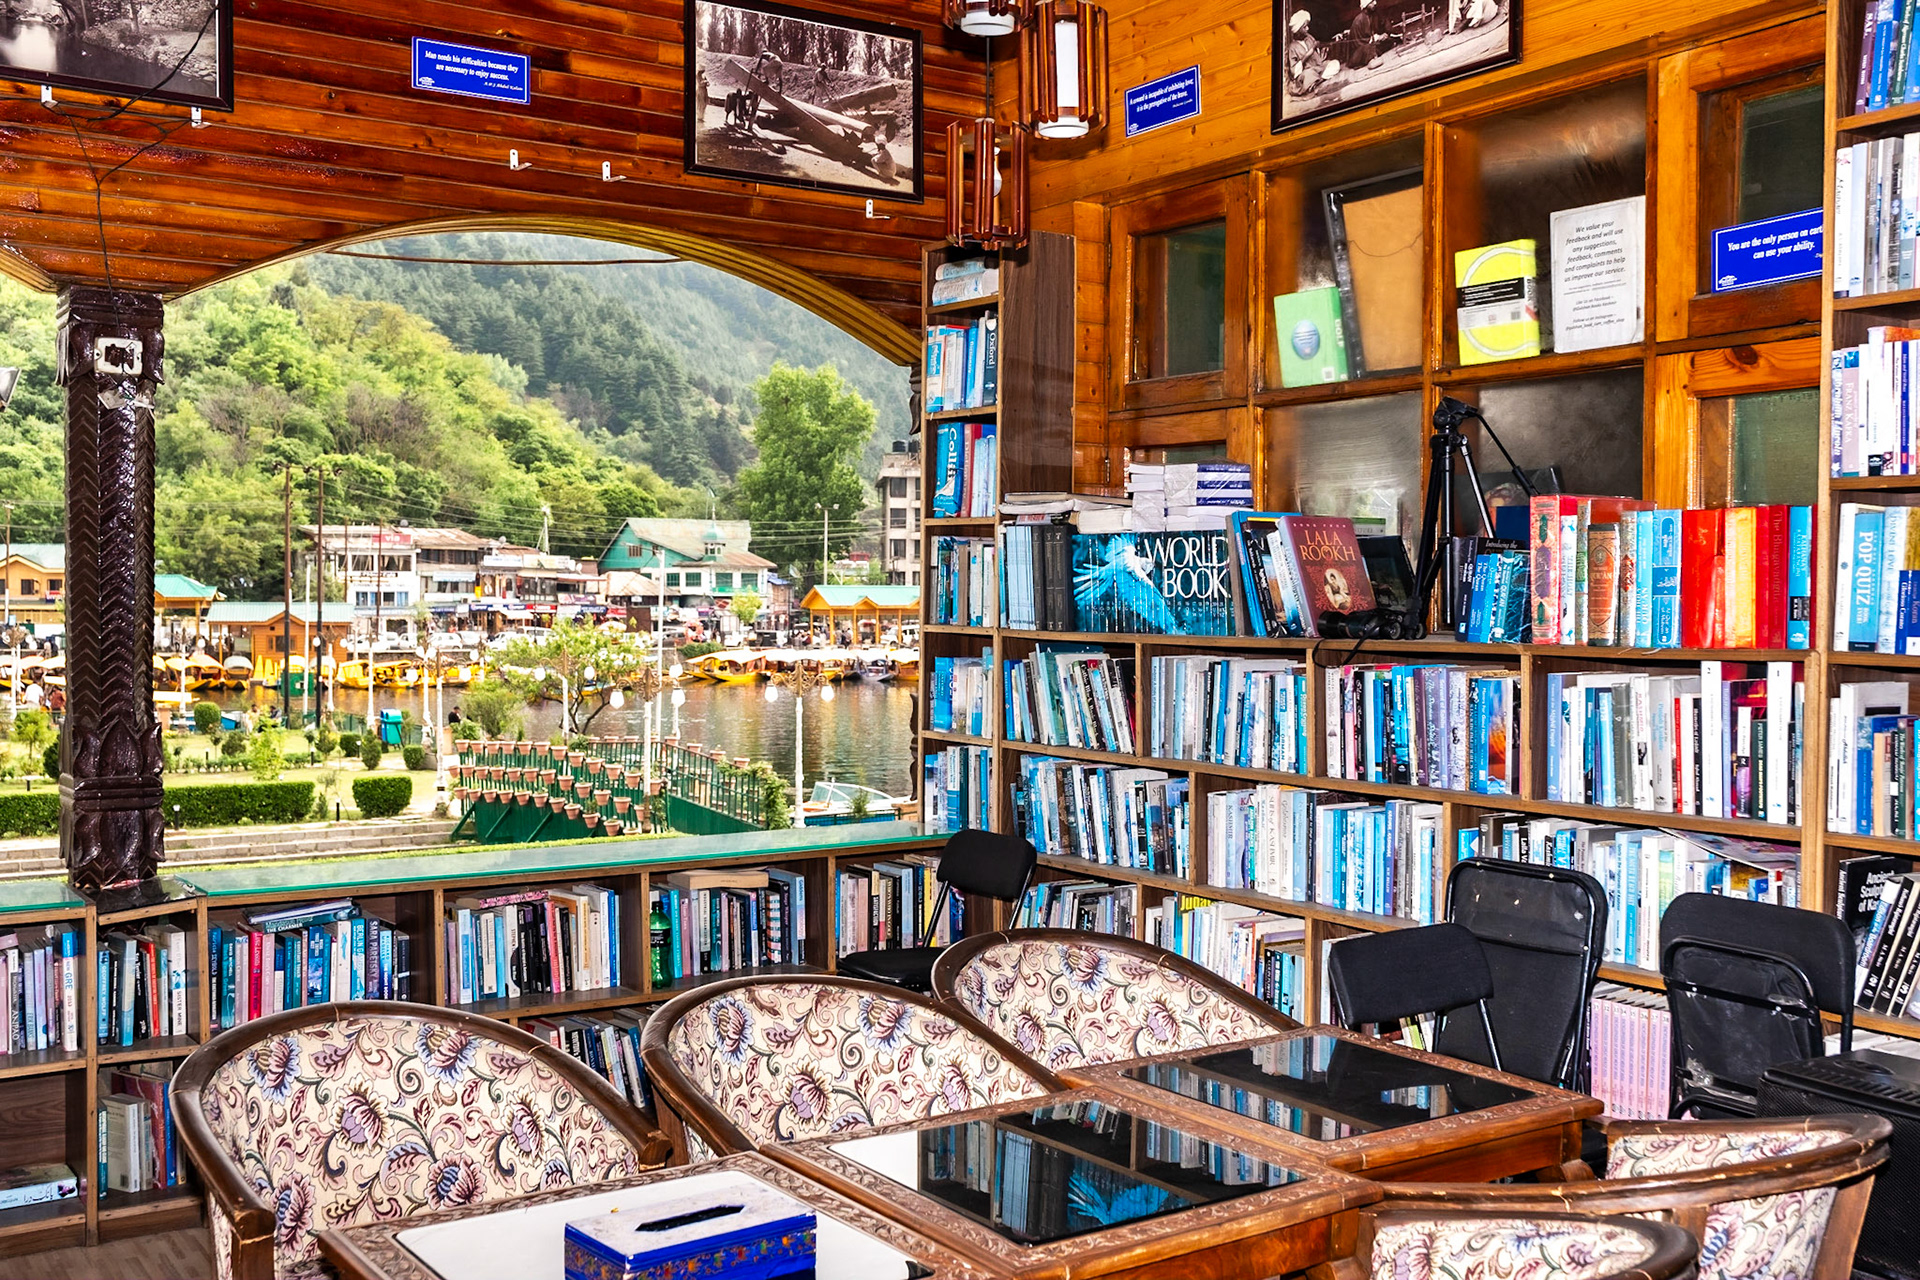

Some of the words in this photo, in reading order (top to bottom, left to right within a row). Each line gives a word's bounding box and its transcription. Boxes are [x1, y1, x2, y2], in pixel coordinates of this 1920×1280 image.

[425, 51, 437, 59] Man
[461, 57, 488, 68] difficulties
[488, 61, 506, 71] because
[508, 64, 518, 74] they
[445, 66, 468, 76] necessary
[476, 70, 489, 79] enjoy
[1586, 223, 1600, 232] value
[1602, 220, 1614, 230] your
[1566, 234, 1590, 246] feedback
[1572, 244, 1583, 252] any
[1584, 240, 1617, 251] suggestions,
[1728, 242, 1739, 251] You
[1752, 237, 1761, 246] the
[1762, 234, 1776, 245] only
[1778, 231, 1799, 244] person
[1810, 226, 1823, 235] eart
[1566, 253, 1593, 264] feedback,
[1594, 248, 1623, 258] comments
[1753, 251, 1764, 259] can
[1766, 248, 1776, 257] use
[1777, 246, 1792, 257] your
[1793, 240, 1815, 252] ability.
[1576, 260, 1605, 273] complaints
[1614, 256, 1626, 266] help
[1572, 272, 1594, 283] improve
[1605, 266, 1626, 275] service.
[1845, 414, 1853, 443] KAFKA
[1773, 511, 1782, 531] The
[1304, 530, 1343, 546] LALA
[1888, 515, 1897, 546] DIVINE
[1144, 536, 1230, 567] WORLD
[1300, 545, 1356, 561] ROOKH
[1486, 540, 1510, 549] Introducing
[1859, 531, 1874, 563] POP
[1888, 549, 1896, 571] LOVE
[1164, 567, 1232, 598] BOOK
[1855, 566, 1870, 606] QUIZ
[1858, 902, 1866, 913] of
[277, 923, 302, 932] CHARMER
[1860, 933, 1876, 967] Boardroom
[65, 973, 73, 990] GRE
